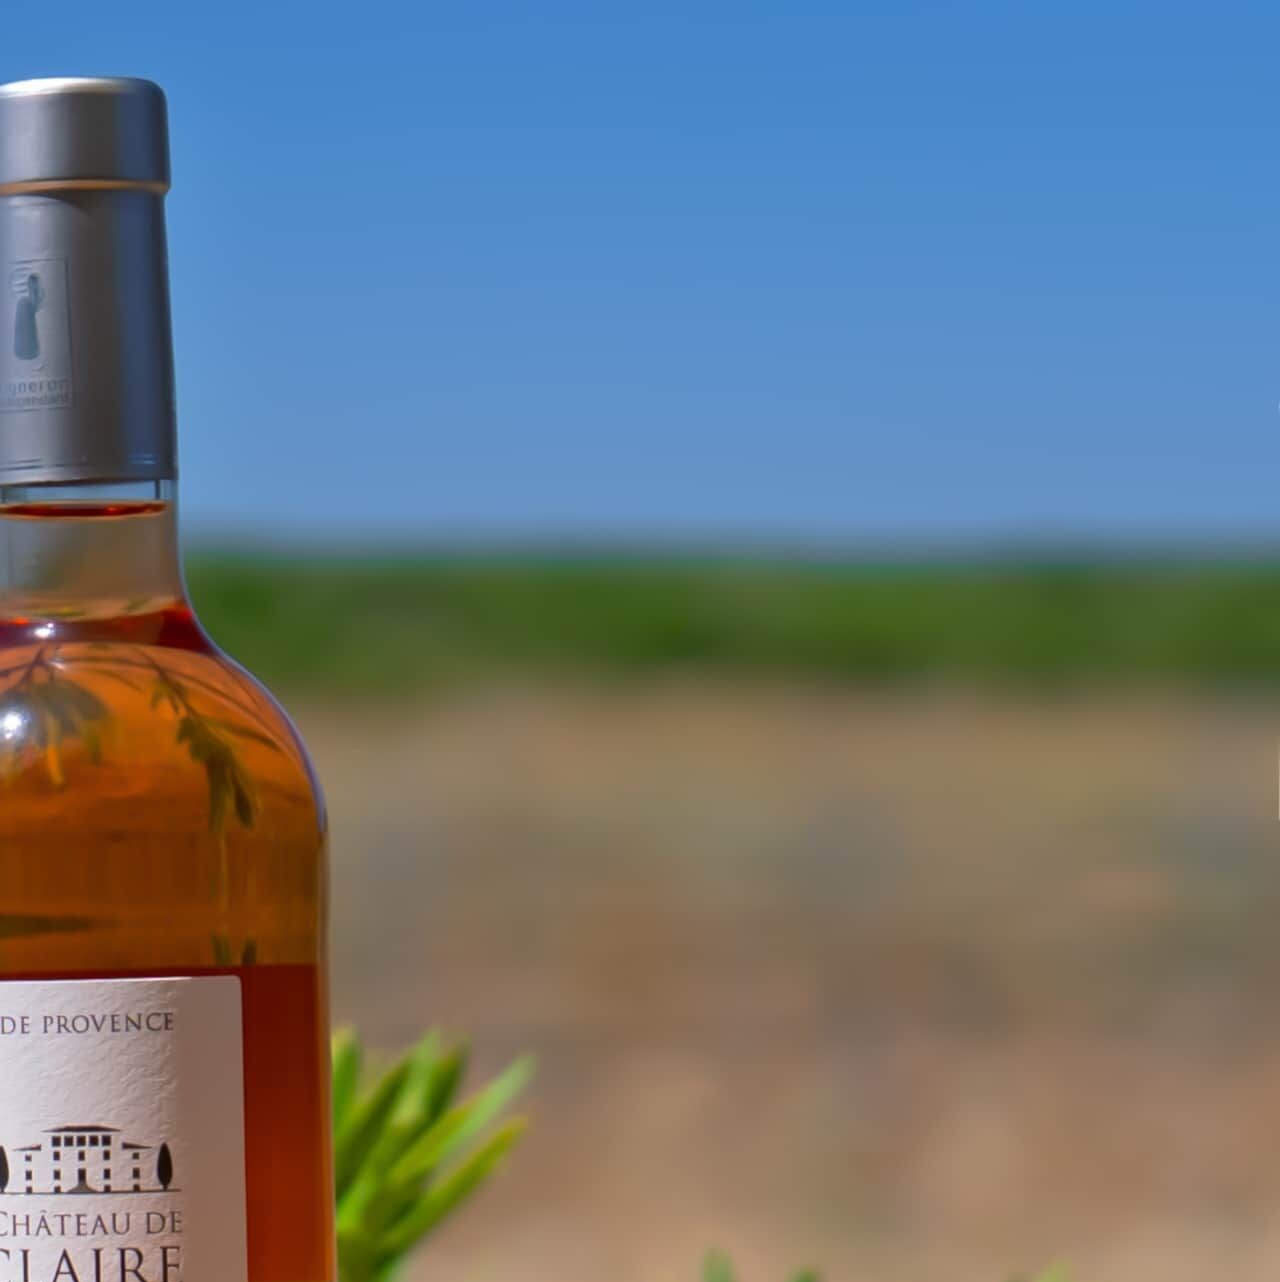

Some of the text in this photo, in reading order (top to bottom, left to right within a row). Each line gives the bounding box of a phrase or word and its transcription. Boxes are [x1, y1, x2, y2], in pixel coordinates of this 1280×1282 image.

[0, 1015, 31, 1035] DE
[42, 1012, 175, 1034] PROVENCE
[145, 1211, 183, 1235] DE
